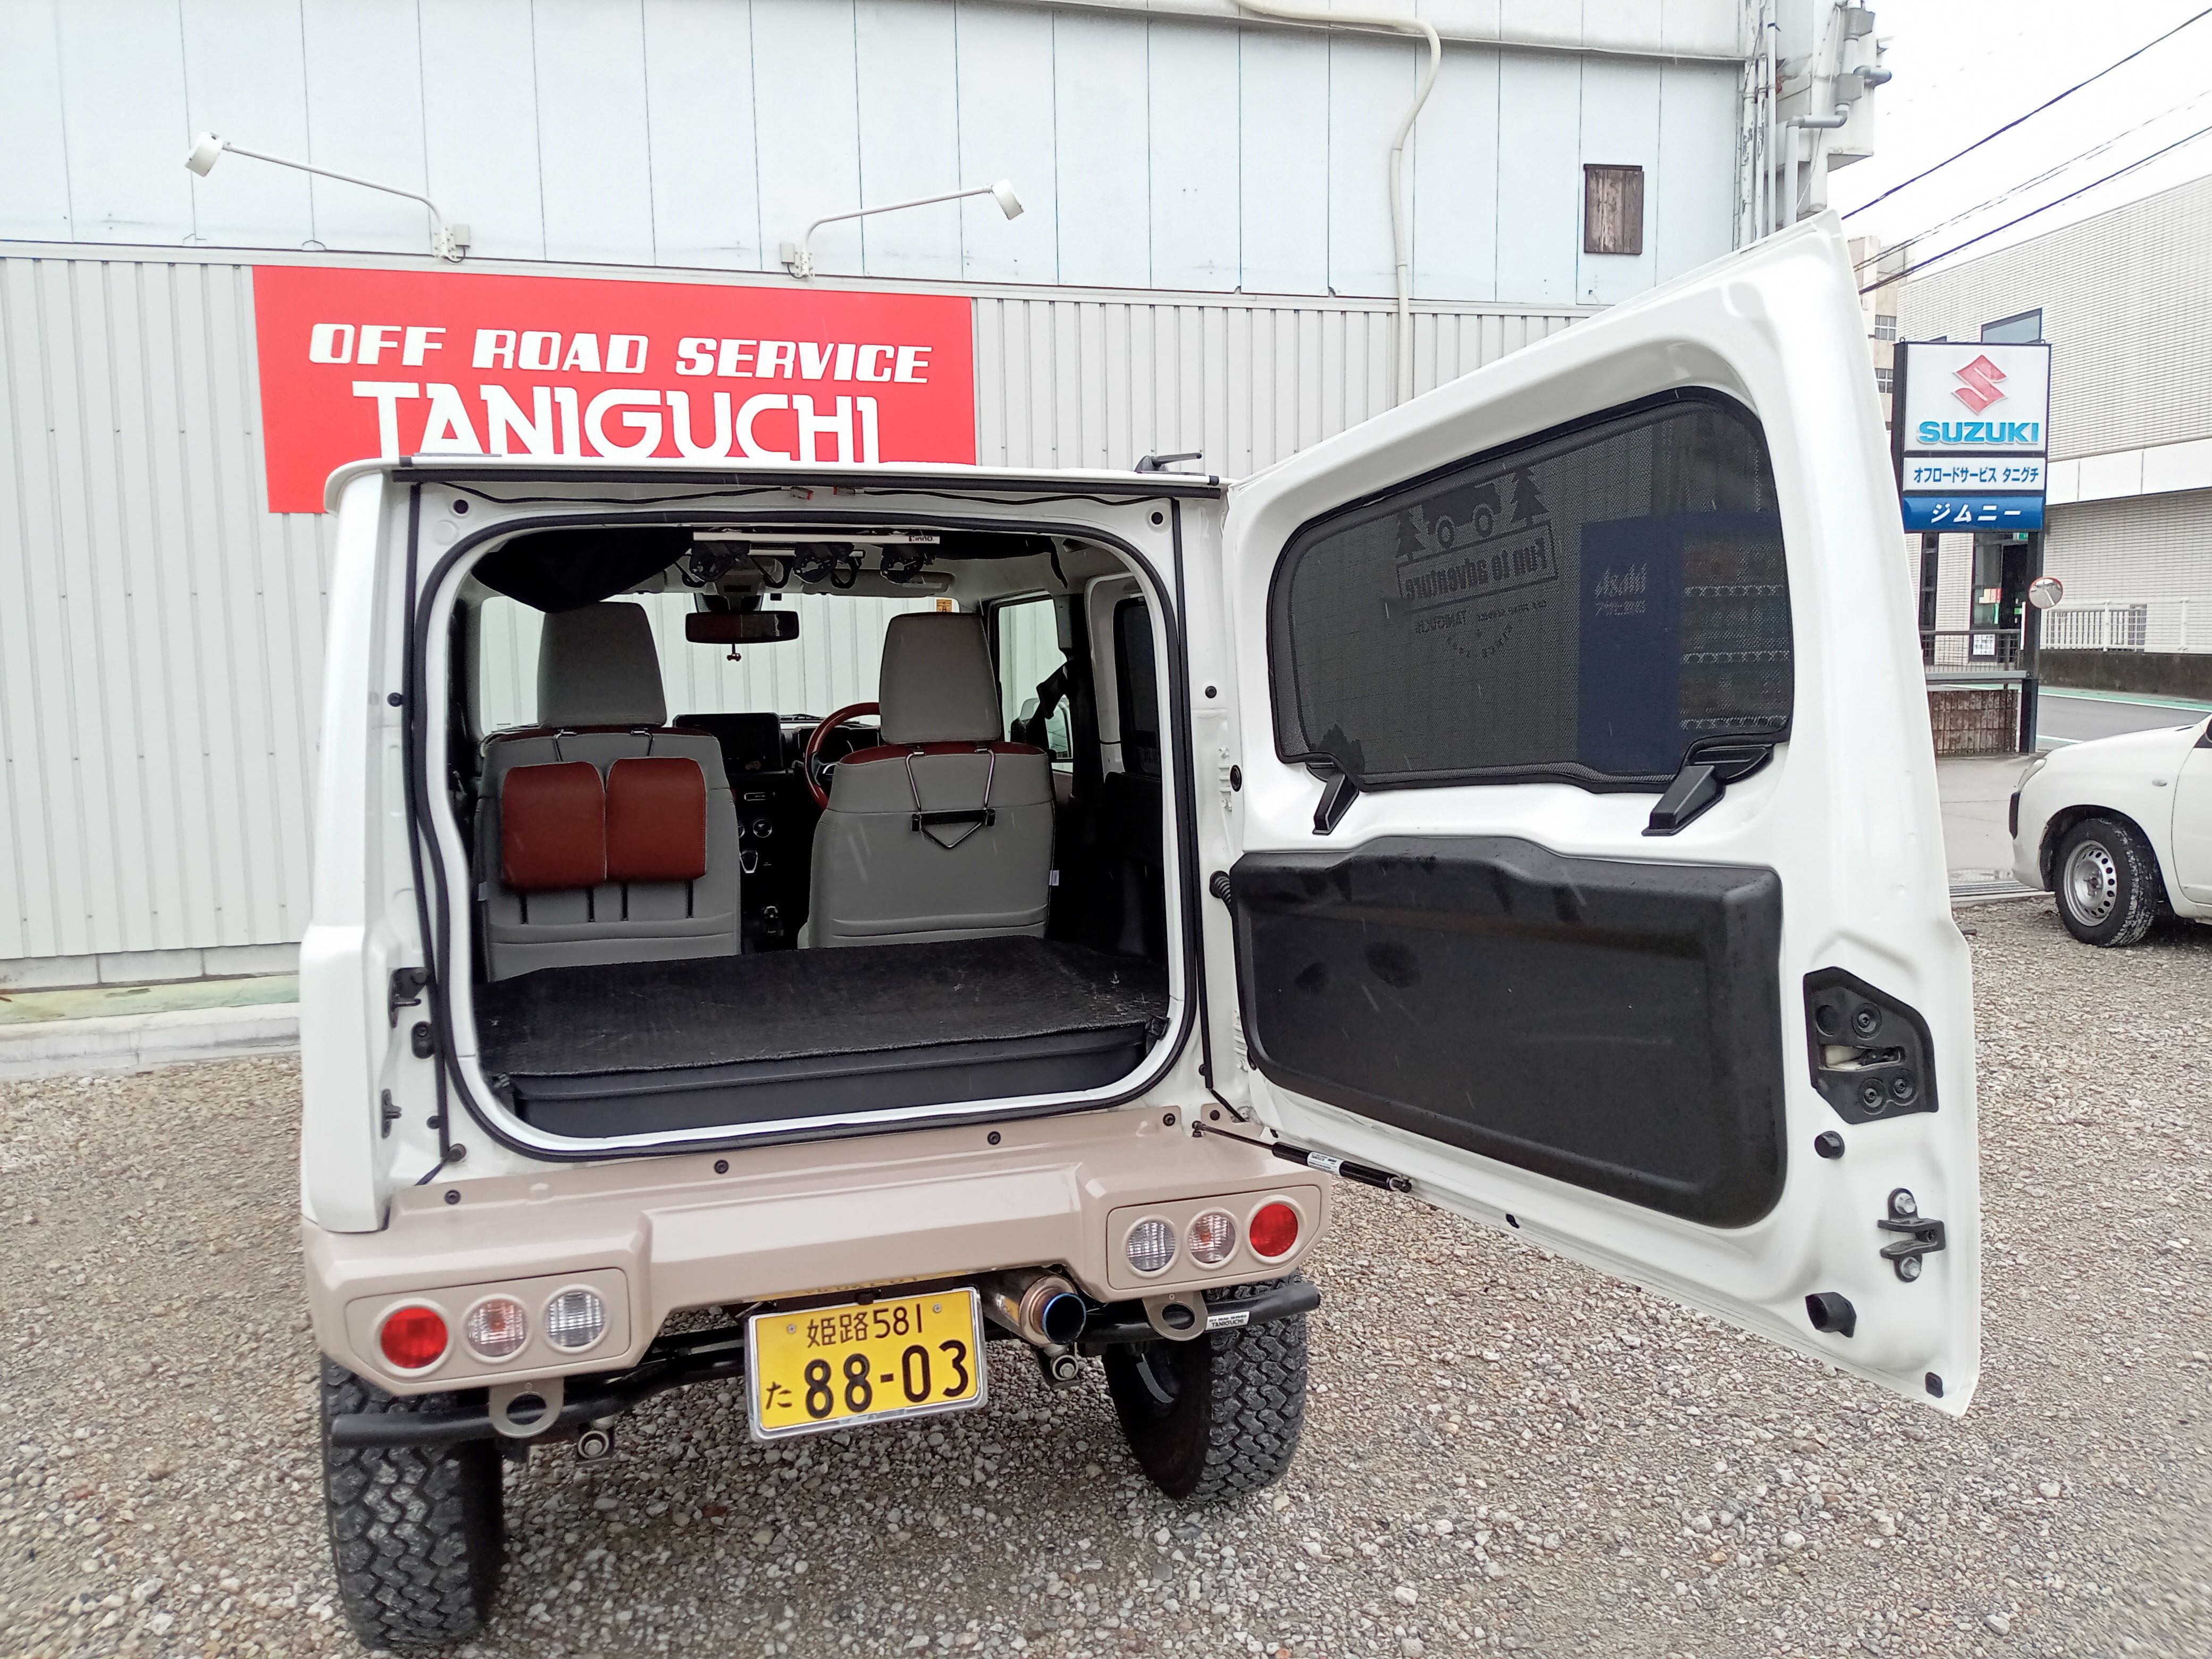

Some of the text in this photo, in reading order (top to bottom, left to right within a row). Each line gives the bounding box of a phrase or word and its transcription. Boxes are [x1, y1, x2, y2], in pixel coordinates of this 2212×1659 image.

[308, 323, 934, 384] OFF ROAD SERVICE
[352, 381, 881, 464] TANIGUCHI
[1917, 421, 2039, 444] SUZUKI
[1914, 467, 2039, 483] オフロードサービス タニグチ
[1931, 502, 2021, 524] ジムニー
[766, 1339, 969, 1419] た 88-03
